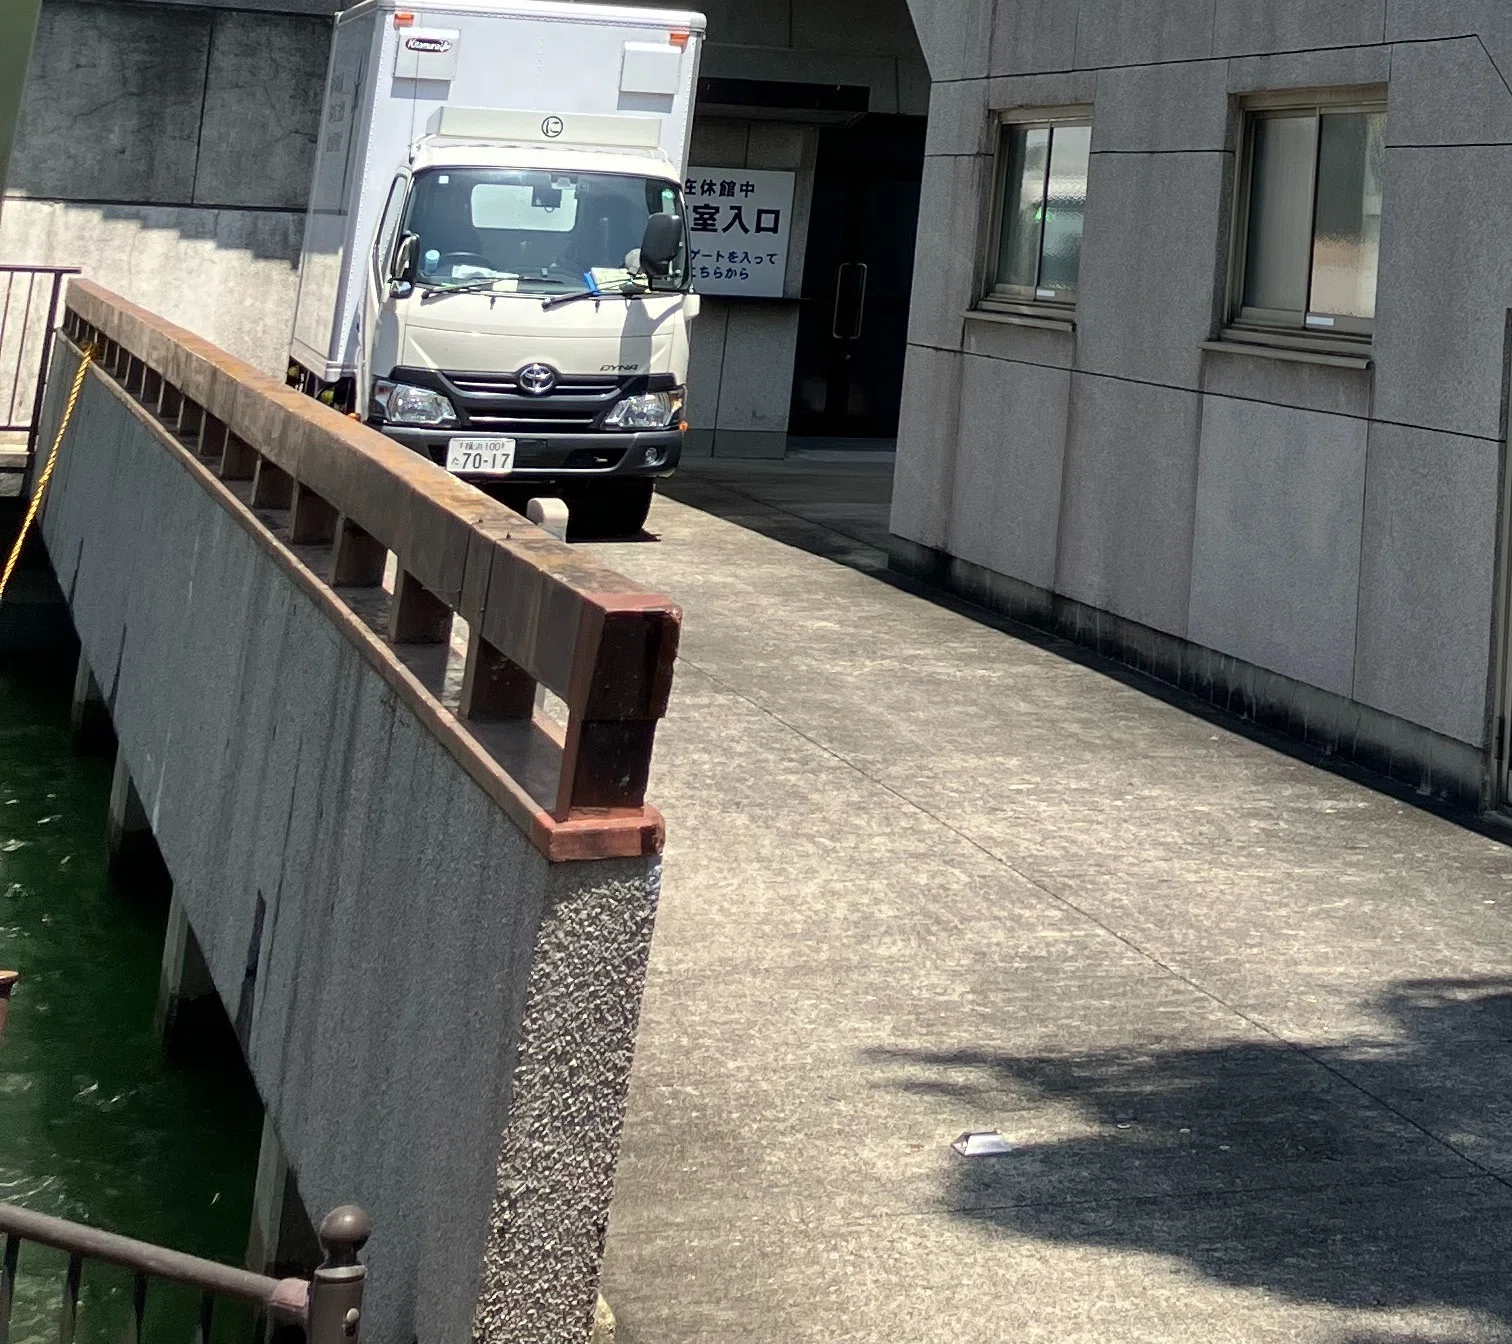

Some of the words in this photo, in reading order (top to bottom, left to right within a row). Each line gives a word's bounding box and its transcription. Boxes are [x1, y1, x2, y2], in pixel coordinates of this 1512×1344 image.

[686, 203, 781, 235] 室入口
[692, 265, 749, 280] ちらから
[462, 452, 511, 469] 70-17
